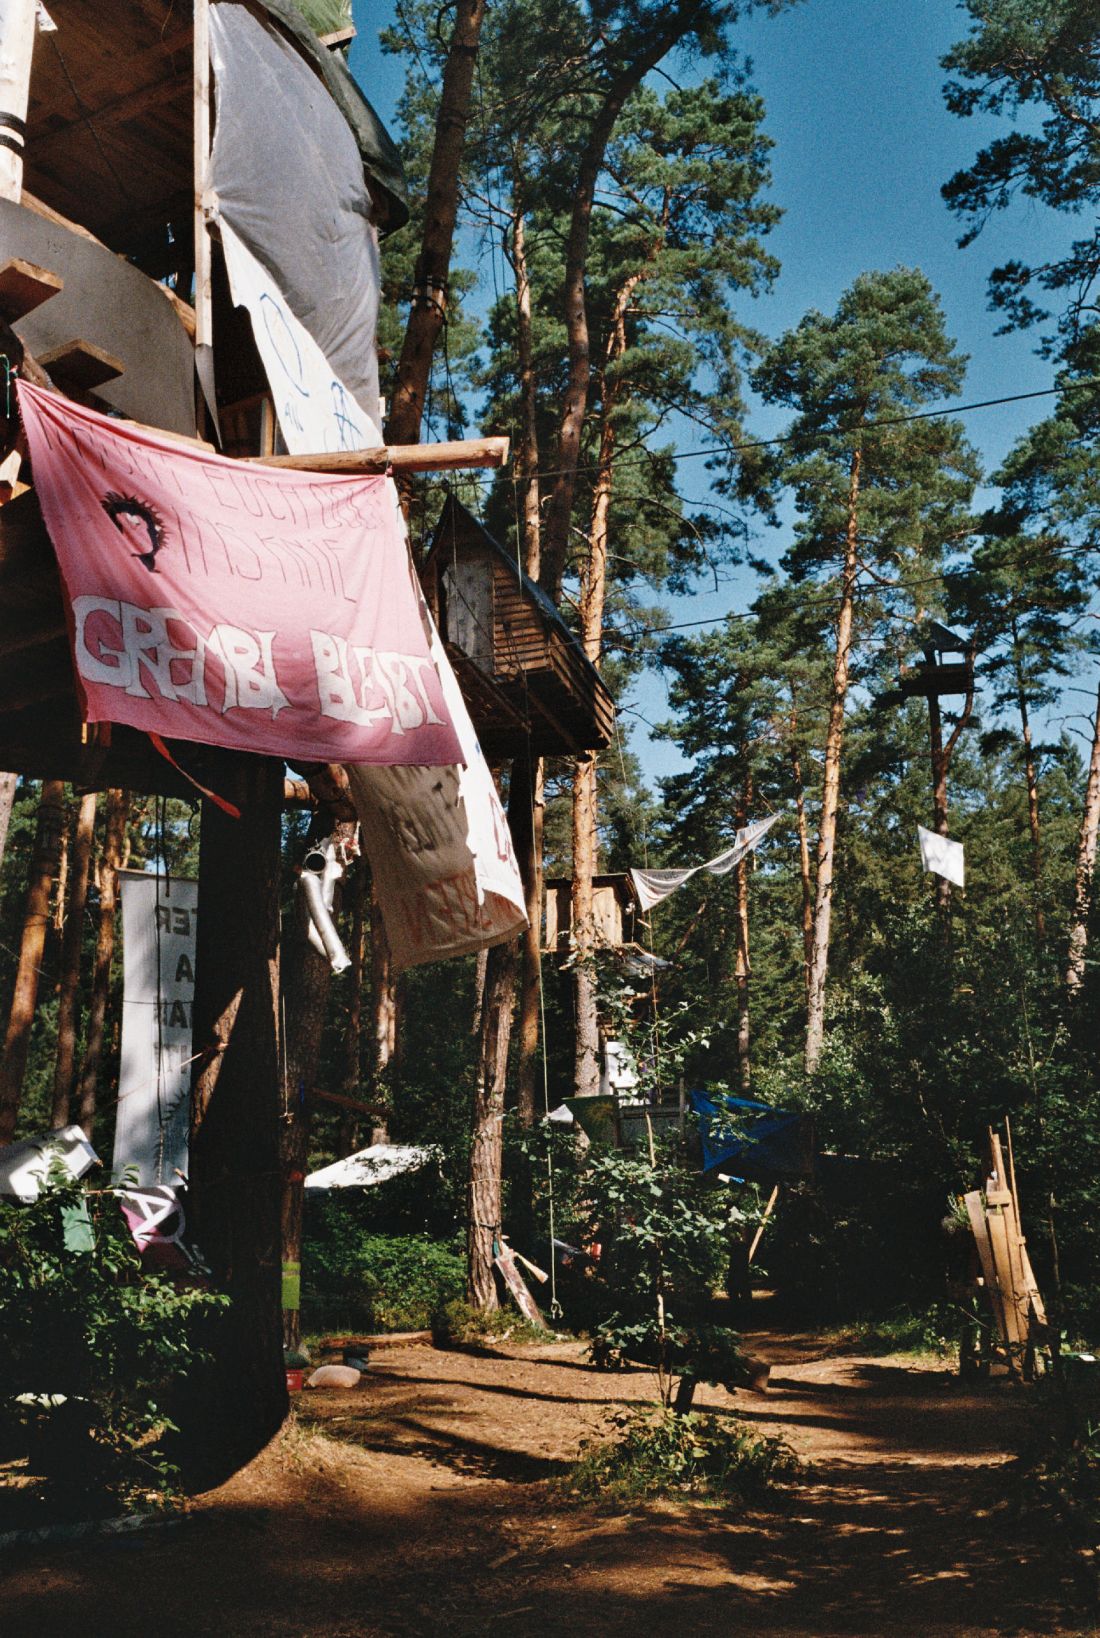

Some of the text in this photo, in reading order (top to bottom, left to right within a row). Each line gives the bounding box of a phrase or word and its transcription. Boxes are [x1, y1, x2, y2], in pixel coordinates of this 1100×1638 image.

[201, 464, 311, 530] EUCH
[171, 505, 263, 581] INS
[309, 627, 448, 736] BLEIBT
